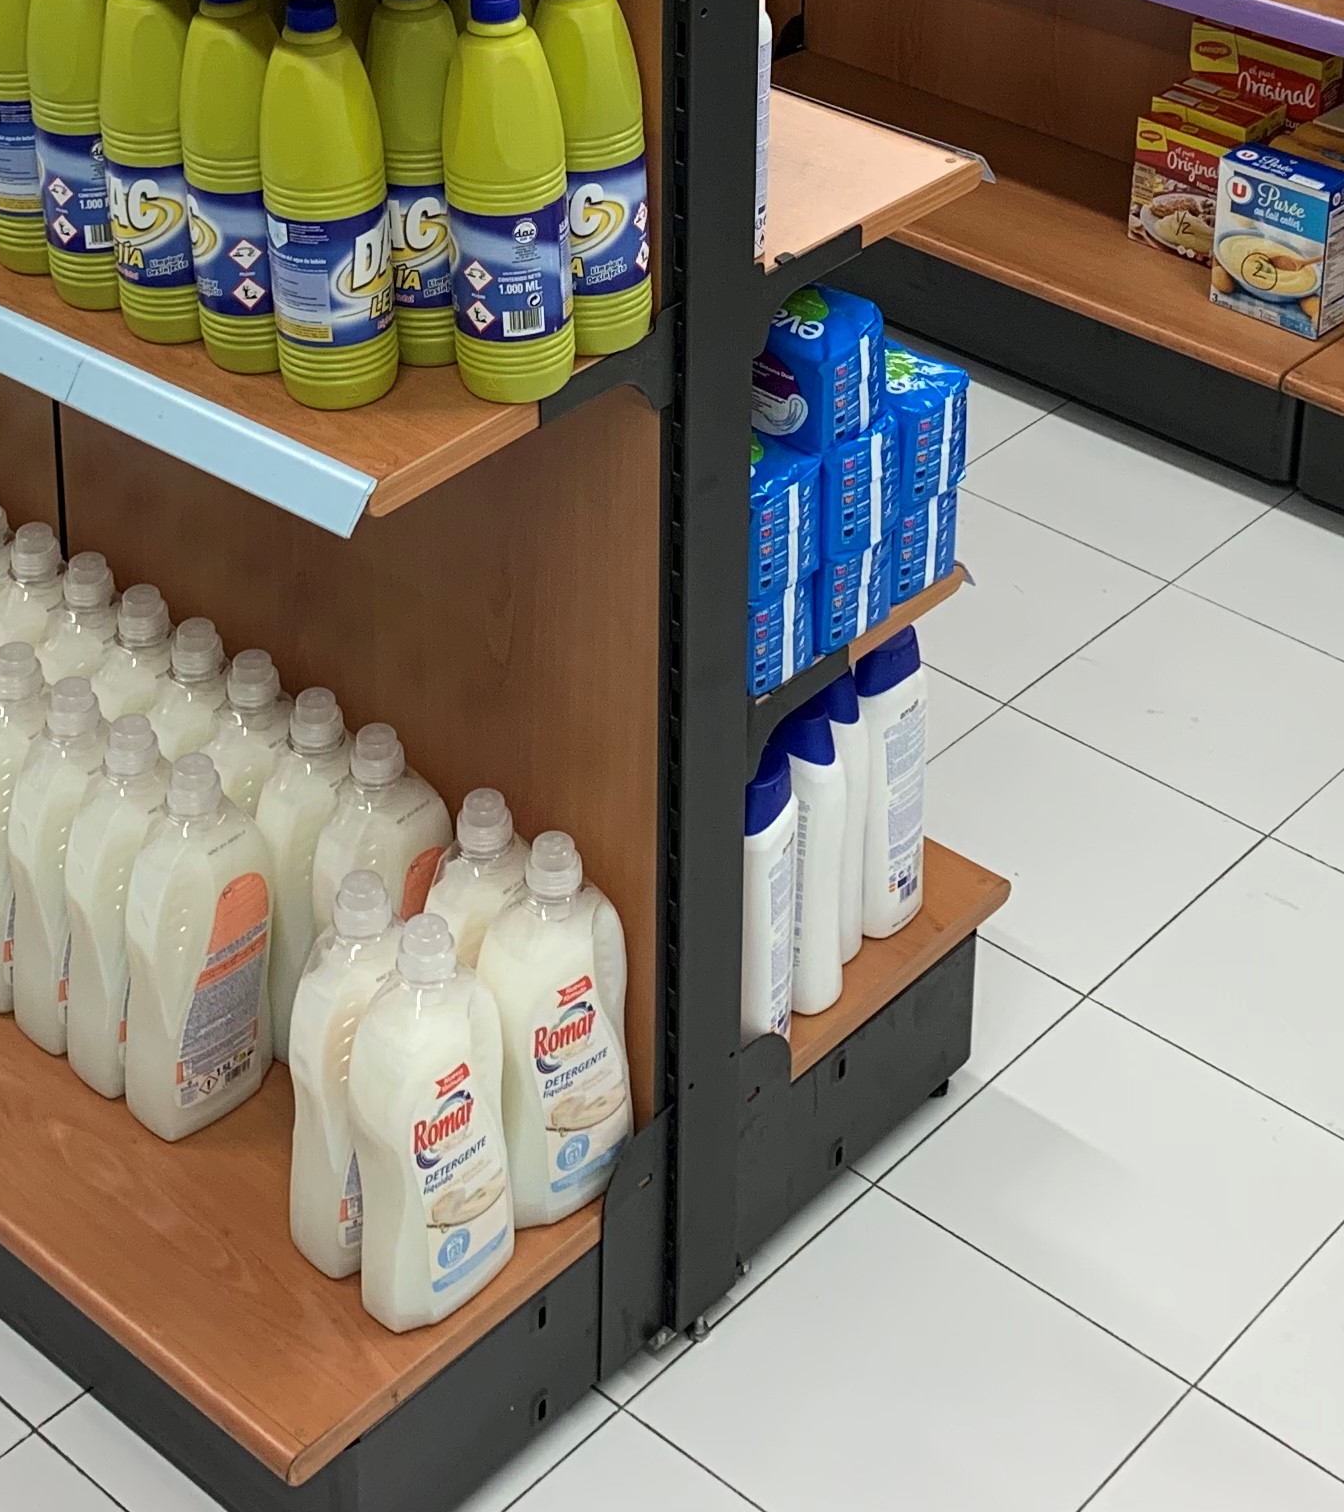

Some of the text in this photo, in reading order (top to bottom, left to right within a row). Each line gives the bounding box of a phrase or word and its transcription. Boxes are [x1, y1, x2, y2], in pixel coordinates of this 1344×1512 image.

[1167, 151, 1219, 182] Origina
[79, 199, 103, 210] 1.000
[108, 178, 160, 230] AC
[1232, 183, 1247, 197] U
[1258, 183, 1306, 218] Purée
[499, 280, 542, 295] 1.000 ML
[534, 1009, 597, 1059] Romar
[543, 1046, 609, 1090] DETERGENTE
[413, 1098, 475, 1156] Romar
[424, 1135, 487, 1185] DETERGENTE
